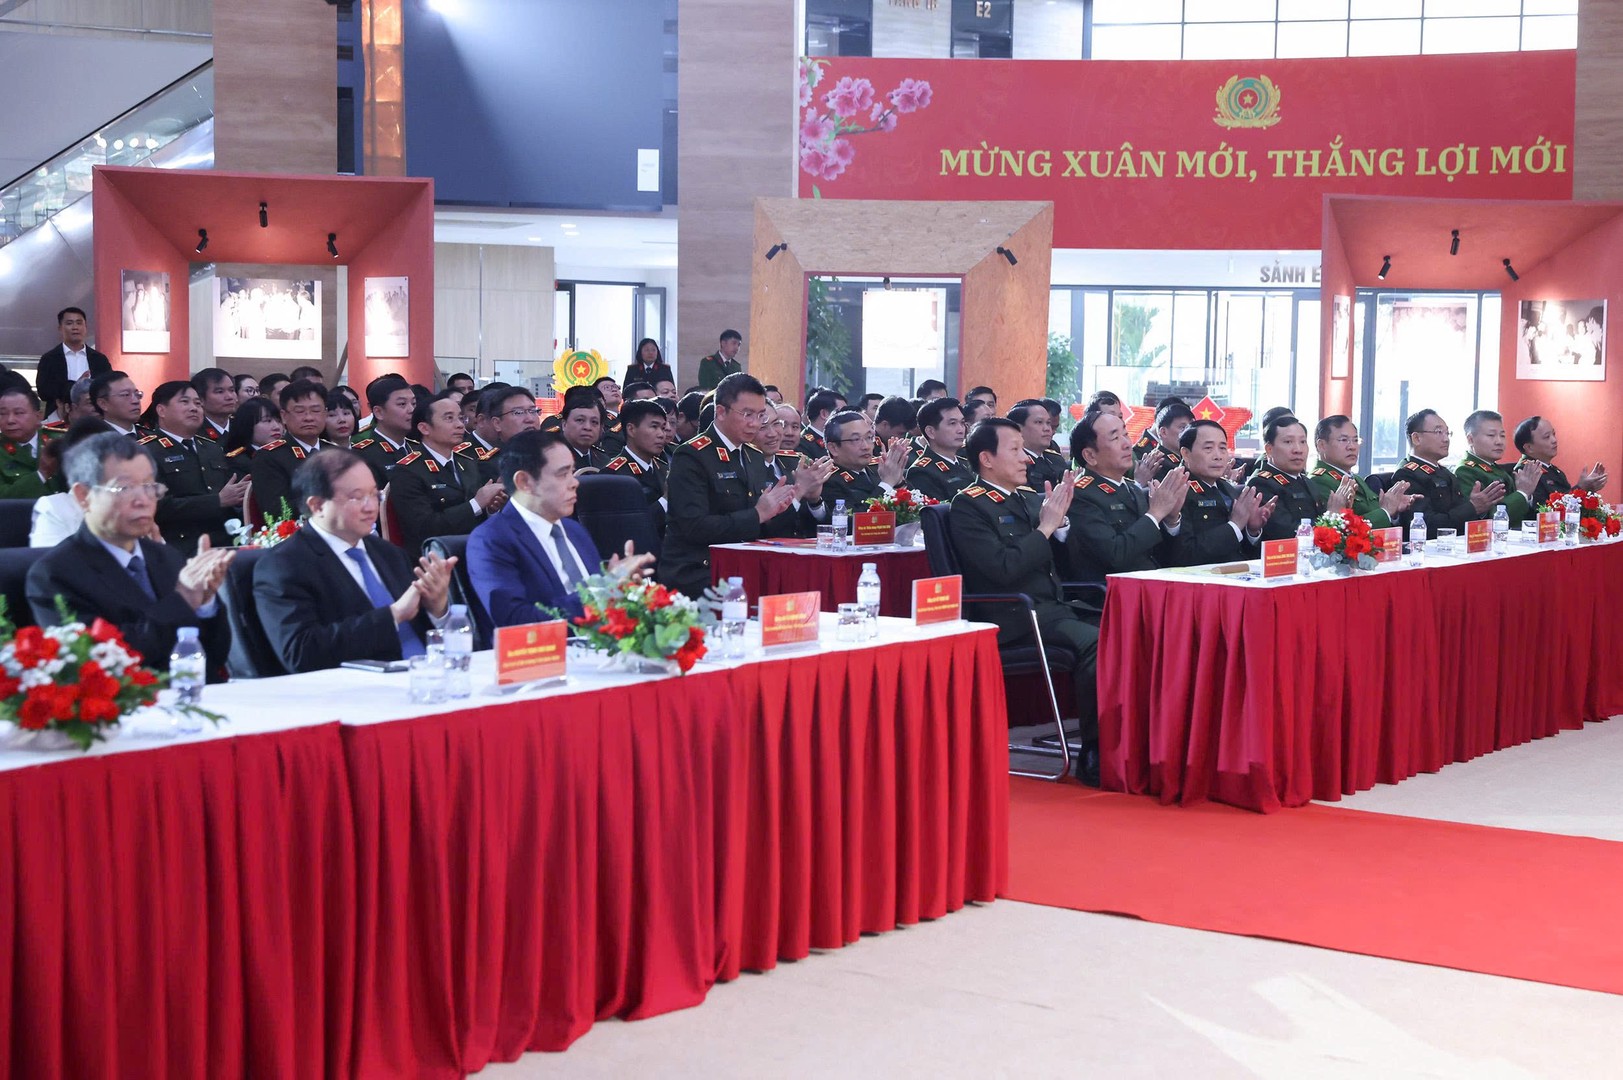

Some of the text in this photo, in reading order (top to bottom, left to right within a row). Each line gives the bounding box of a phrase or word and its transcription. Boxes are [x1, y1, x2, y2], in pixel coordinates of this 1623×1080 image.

[976, 1, 991, 18] E2
[939, 134, 1568, 183] MỪNG XUÂN MỚI, THẮNG LỢI MỚI
[1260, 258, 1306, 283] SẢNH
